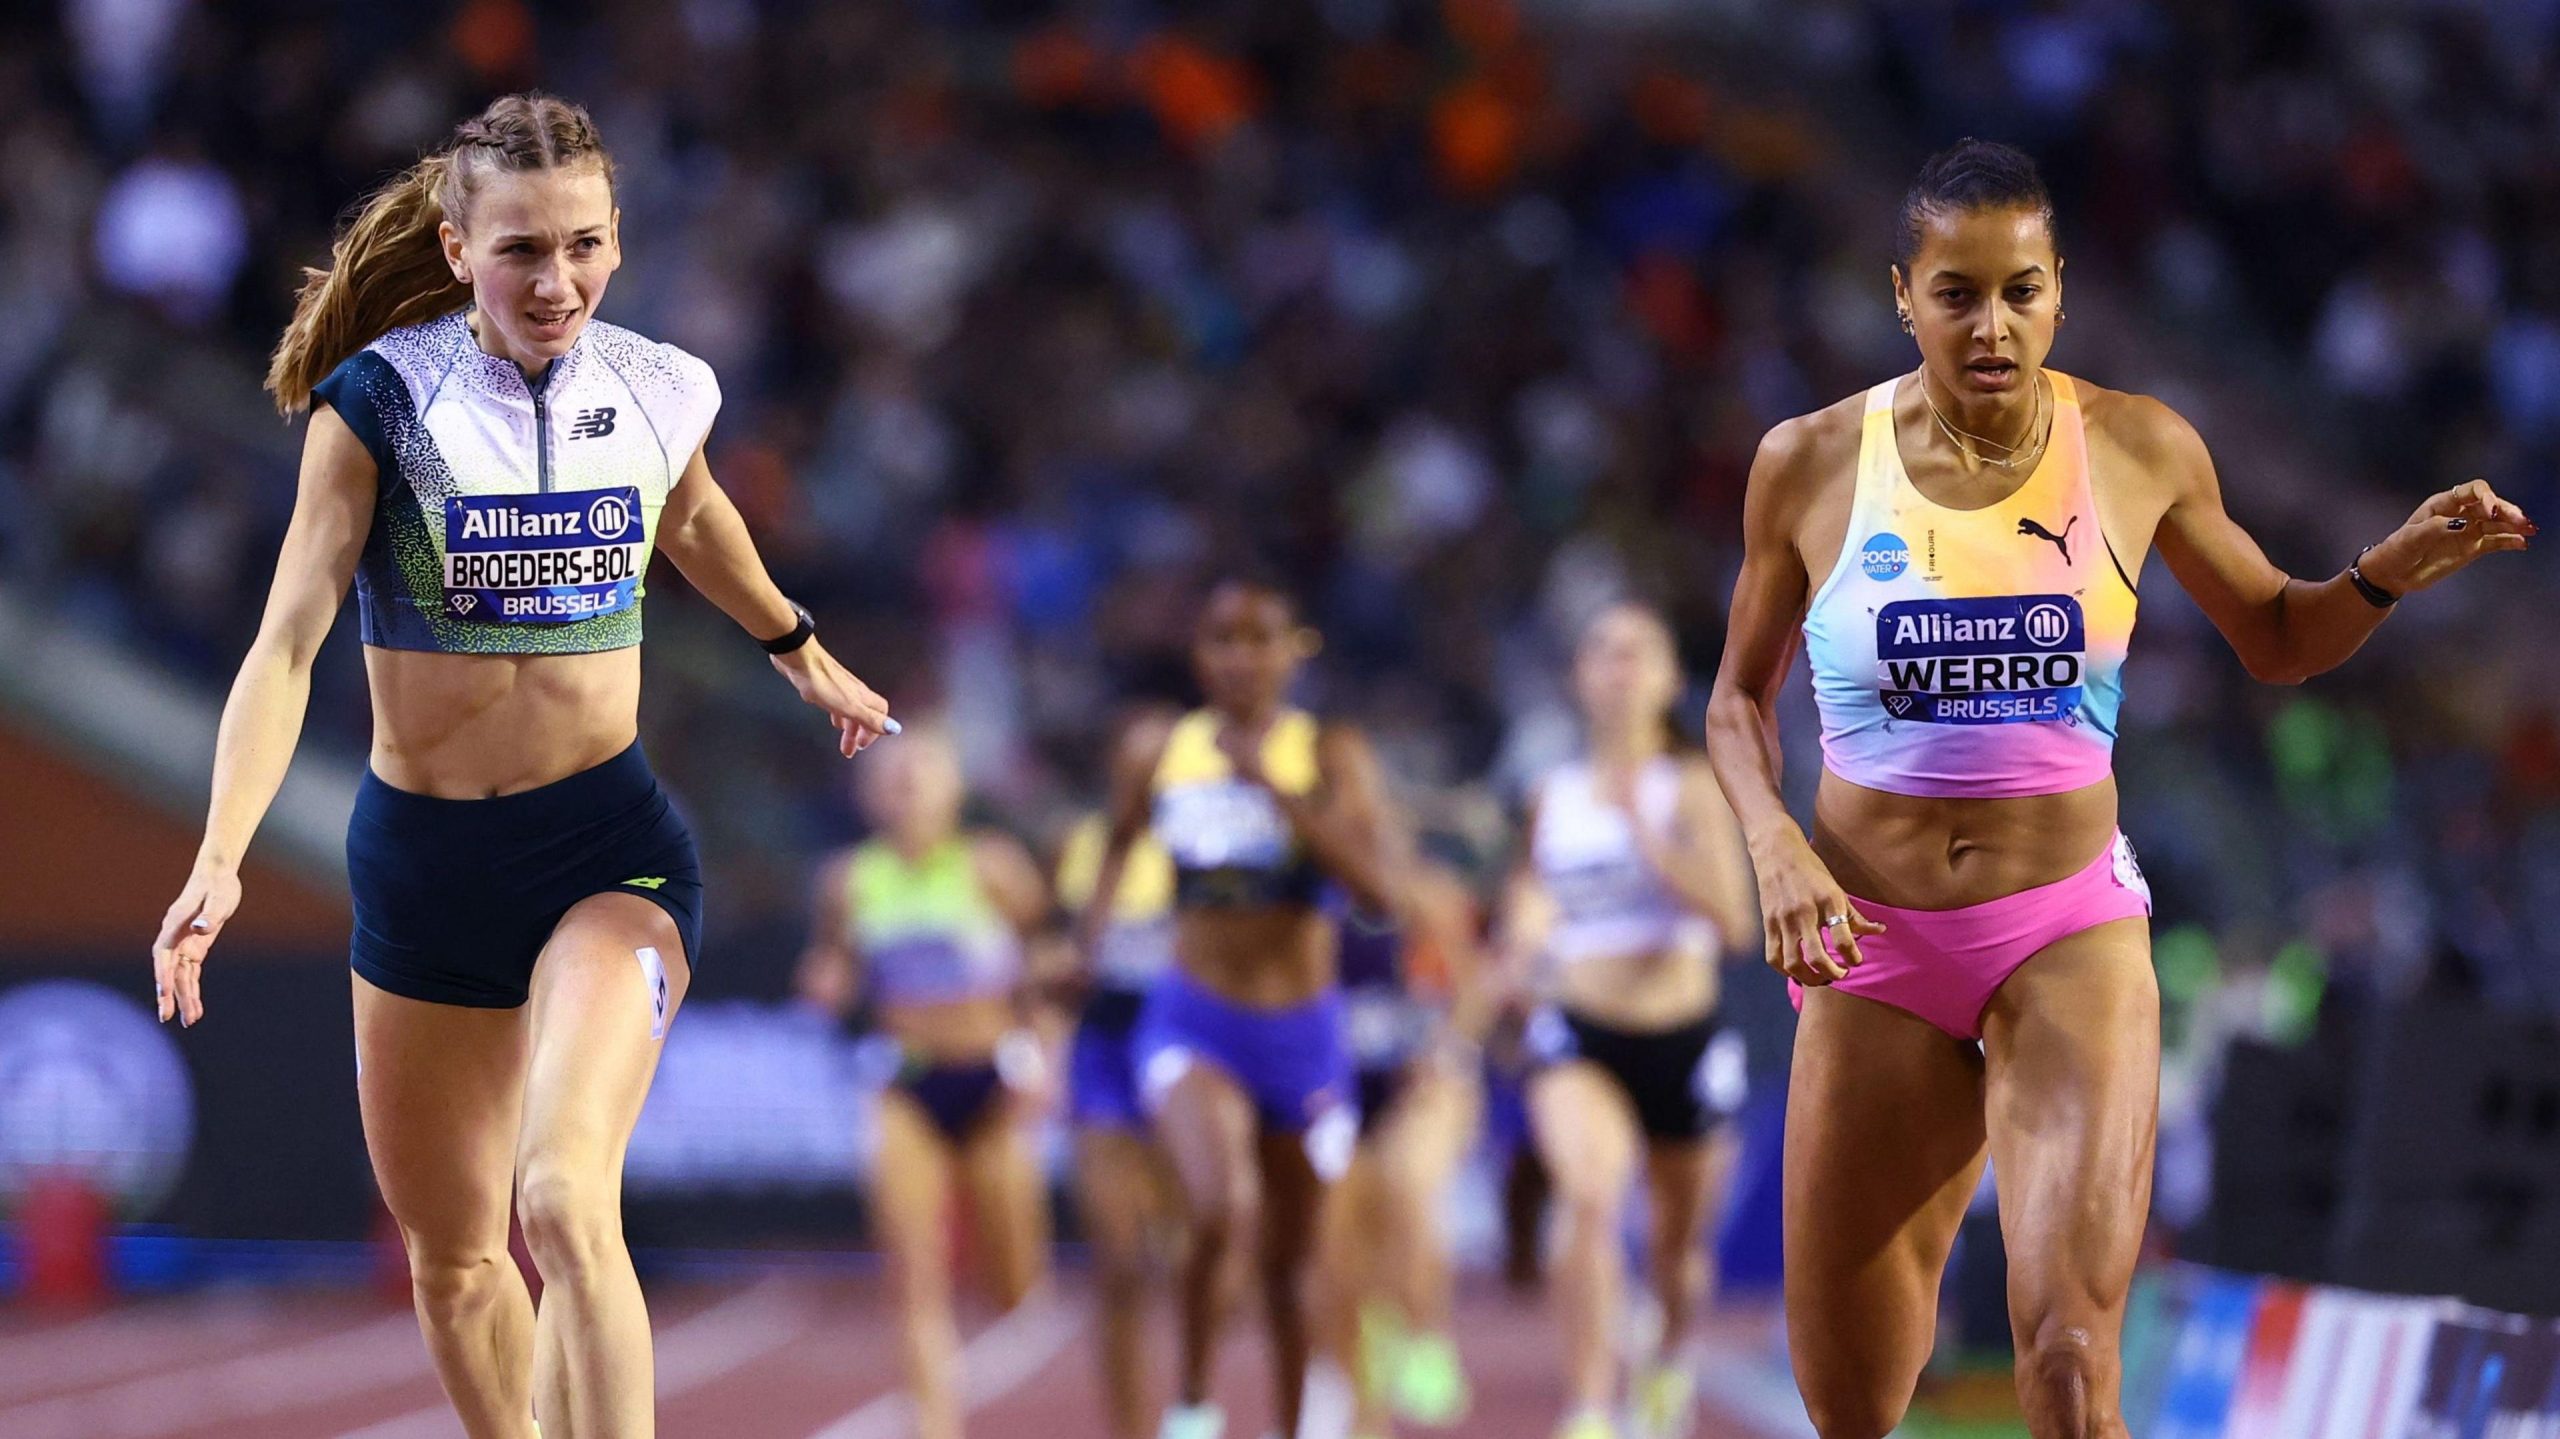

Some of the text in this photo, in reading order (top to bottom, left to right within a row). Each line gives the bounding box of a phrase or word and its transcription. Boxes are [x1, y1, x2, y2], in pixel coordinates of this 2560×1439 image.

[461, 507, 582, 539] Allianz
[453, 547, 635, 587] BROEDERS-BOL
[1862, 550, 1910, 564] FOCUS
[503, 589, 618, 616] BRUSSELS
[1894, 613, 2016, 645] Allianz
[1888, 654, 2078, 691] WERRO
[1937, 696, 2058, 718] BRUSSELS
